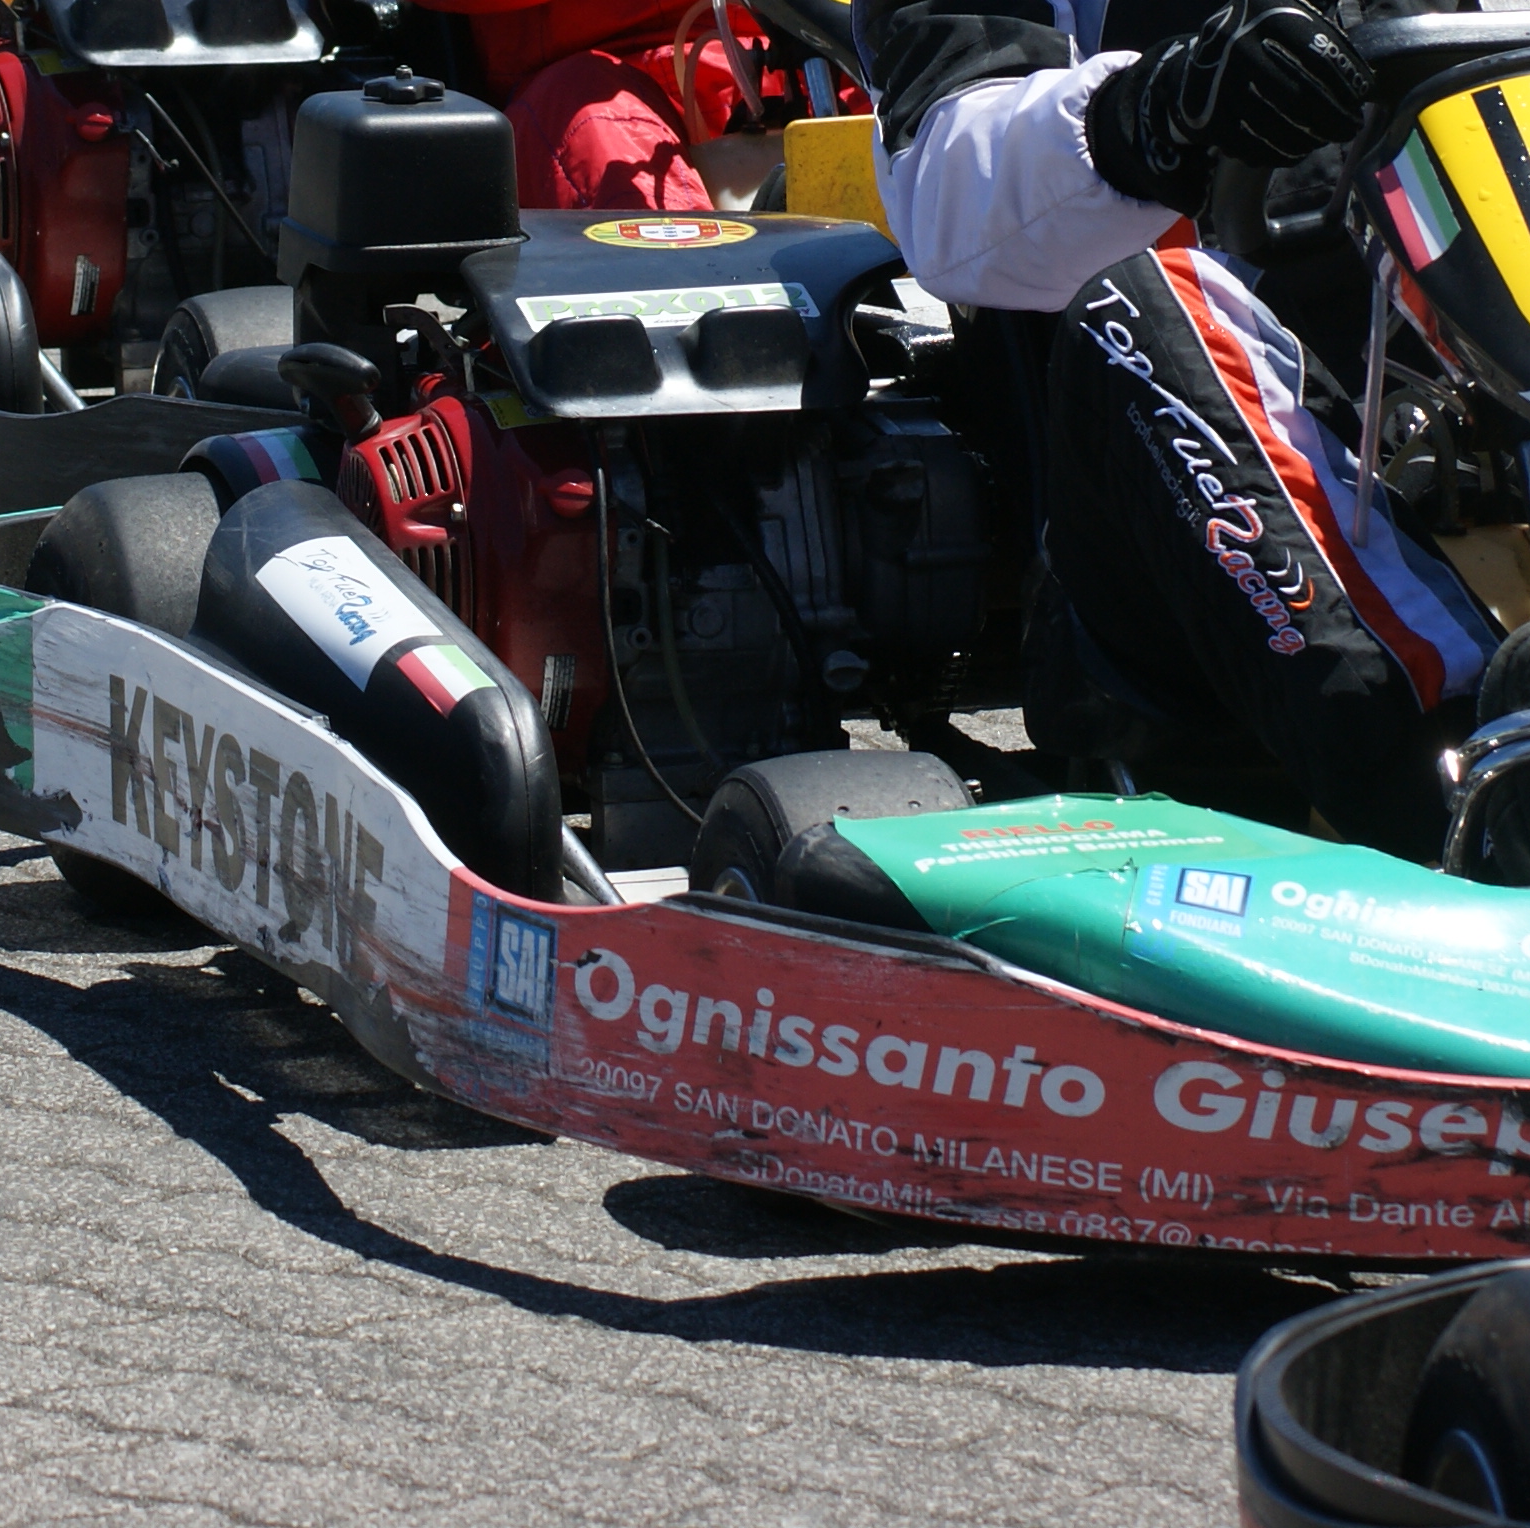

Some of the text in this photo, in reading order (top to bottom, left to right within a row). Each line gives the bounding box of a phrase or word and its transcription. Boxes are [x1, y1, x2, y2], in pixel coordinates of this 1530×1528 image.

[1308, 32, 1370, 97] sparco
[109, 673, 384, 968] KEYSTONE
[940, 828, 1169, 853] THERMOCLIMA
[960, 819, 1116, 841] RIELLO
[1170, 909, 1243, 939] FONDIARIA
[1180, 871, 1243, 914] SAI
[497, 920, 549, 1013] SAI
[574, 947, 1106, 1119] Ognissanto
[673, 1082, 740, 1124] SAN
[752, 1099, 899, 1158] DONATO
[913, 1131, 1124, 1194] MILANESE
[1139, 1165, 1215, 1211] (MI)
[1268, 1184, 1331, 1220] Via
[1348, 1192, 1475, 1230] Dante
